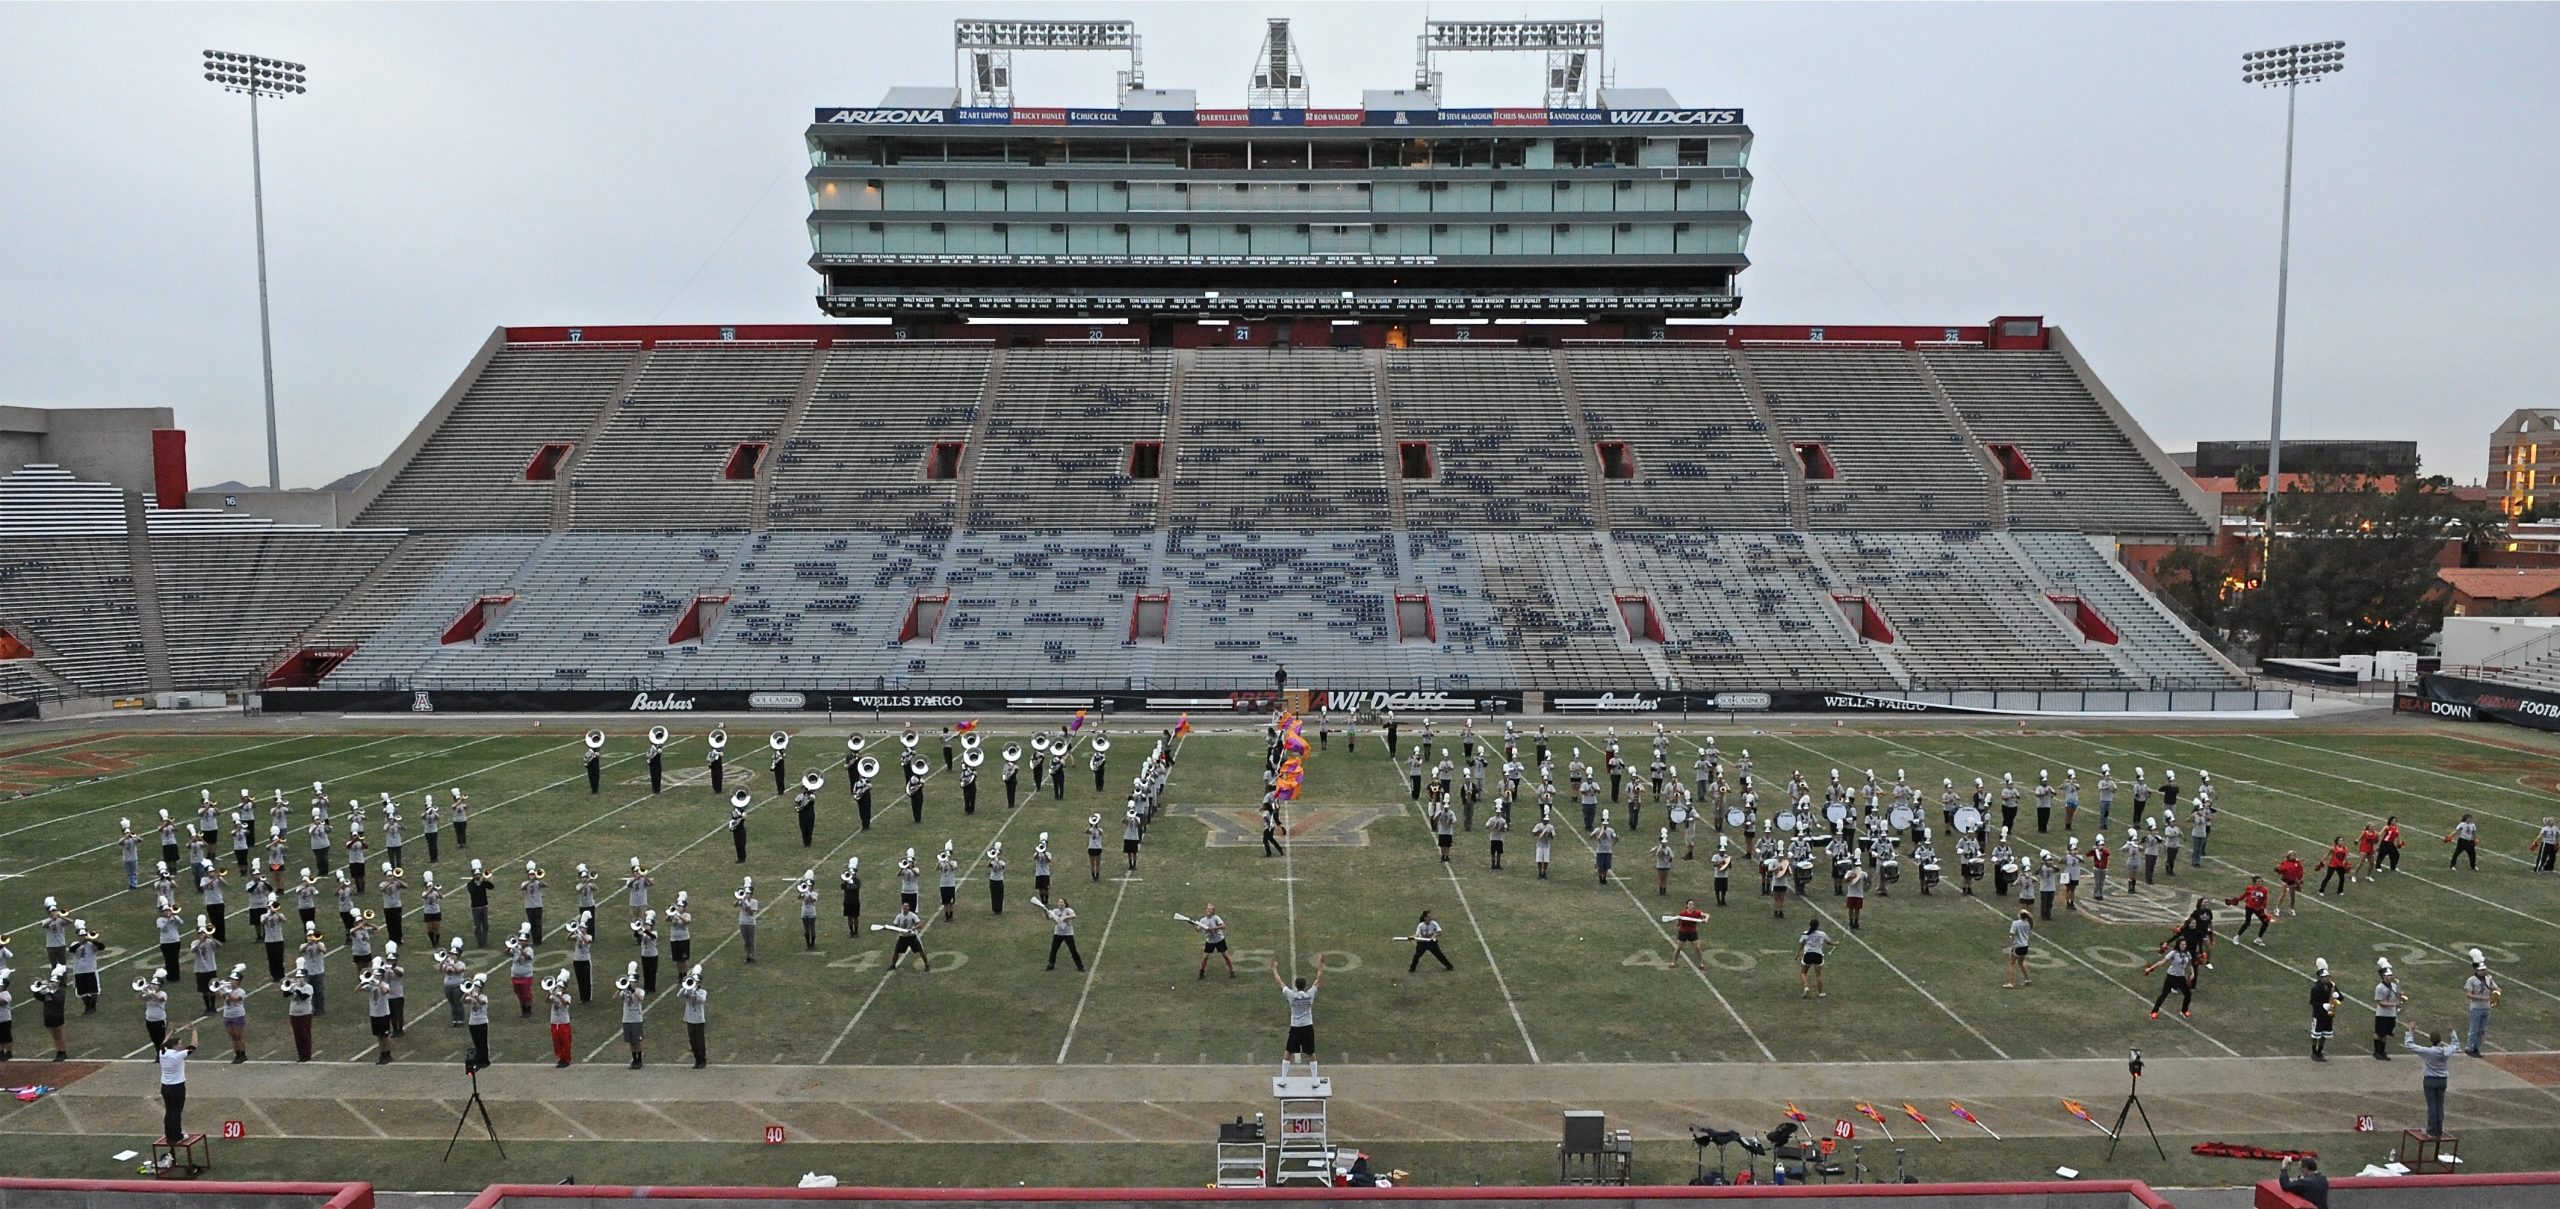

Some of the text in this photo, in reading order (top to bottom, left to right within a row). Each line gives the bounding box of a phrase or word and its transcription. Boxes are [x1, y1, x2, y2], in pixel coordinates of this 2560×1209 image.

[828, 110, 944, 123] ARIZONA
[959, 111, 1009, 120] 22 ART LUPPINO
[1196, 113, 1201, 121] 4
[1305, 112, 1359, 121] 92 ROB WALDROP
[1446, 113, 1460, 121] STEVE
[1461, 113, 1493, 121] McLAUGHLIN
[1580, 113, 1602, 121] CASON
[1610, 111, 1736, 124] WILDCATS
[570, 333, 581, 341] 17
[722, 332, 733, 341] 18
[895, 331, 906, 340] 19
[1089, 331, 1103, 339] 20
[1237, 331, 1248, 340] 21
[1457, 331, 1469, 340] 22
[1652, 332, 1664, 340] 23
[1811, 332, 1823, 341] 24
[1946, 333, 1959, 341] 25
[226, 497, 236, 505] 16
[630, 692, 696, 711] Bashas'
[860, 696, 963, 707] WELLS FARGO
[1228, 691, 1448, 710] ARIZA WILDCATS
[1598, 692, 1661, 710] Bhas'
[1824, 696, 1875, 708] WELLS
[2431, 702, 2472, 718] DOWN
[2372, 942, 2520, 965] 20
[1232, 949, 1362, 973] 50
[1621, 950, 1758, 971] 40
[1294, 1119, 1310, 1133] 50
[1836, 1121, 1851, 1137] 40
[2359, 1116, 2373, 1131] 30
[225, 1122, 240, 1138] 30
[766, 1127, 782, 1143] 40
